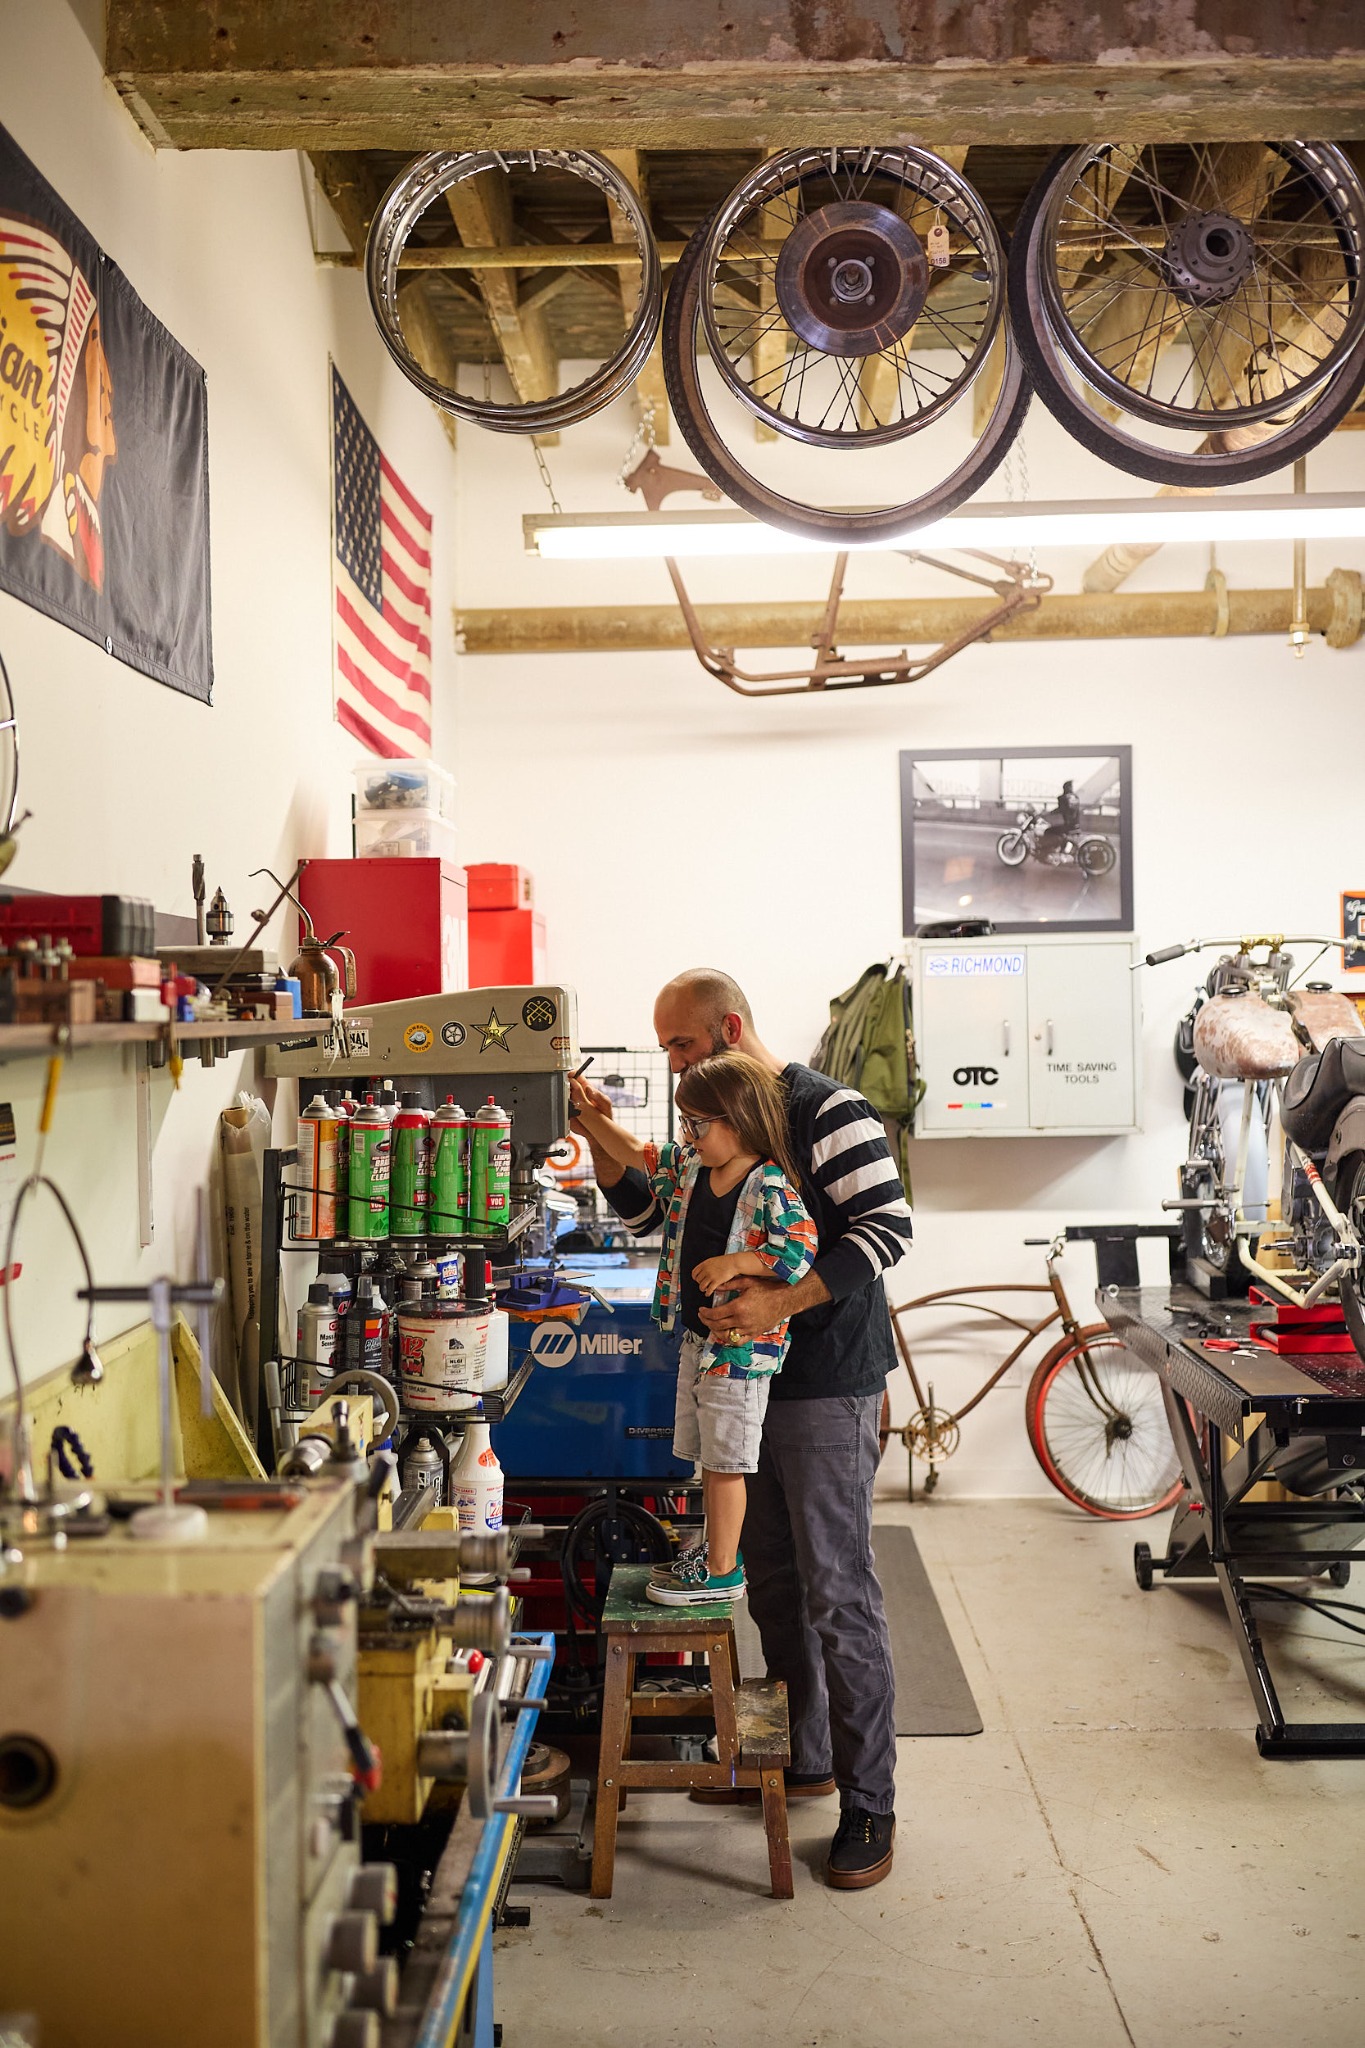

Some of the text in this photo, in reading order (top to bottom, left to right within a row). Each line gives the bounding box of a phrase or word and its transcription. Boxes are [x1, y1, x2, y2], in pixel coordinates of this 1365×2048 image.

[951, 957, 1021, 973] RICHMOND
[1047, 1062, 1117, 1072] TIME SAVING
[953, 1066, 999, 1086] OTC
[1065, 1075, 1099, 1084] TOOLS
[490, 1197, 502, 1206] VOC
[580, 1334, 642, 1355] Miller
